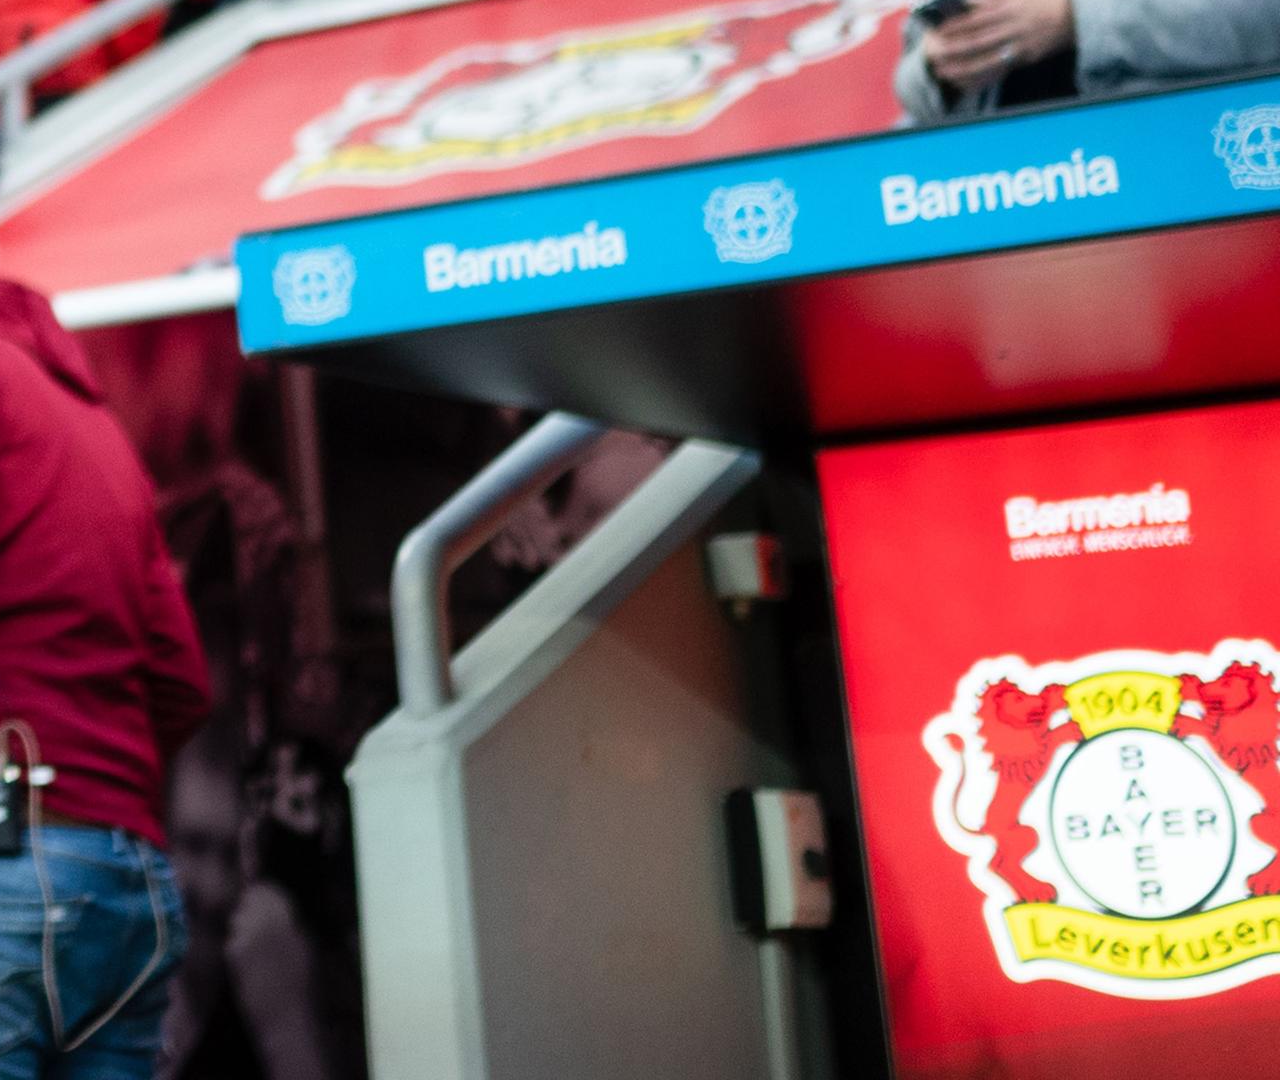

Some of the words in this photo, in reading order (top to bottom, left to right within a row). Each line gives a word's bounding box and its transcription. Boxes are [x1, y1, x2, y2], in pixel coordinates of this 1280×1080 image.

[1080, 687, 1164, 721] 1904
[1066, 808, 1219, 841] BAYER
[1120, 744, 1164, 905] BAYER
